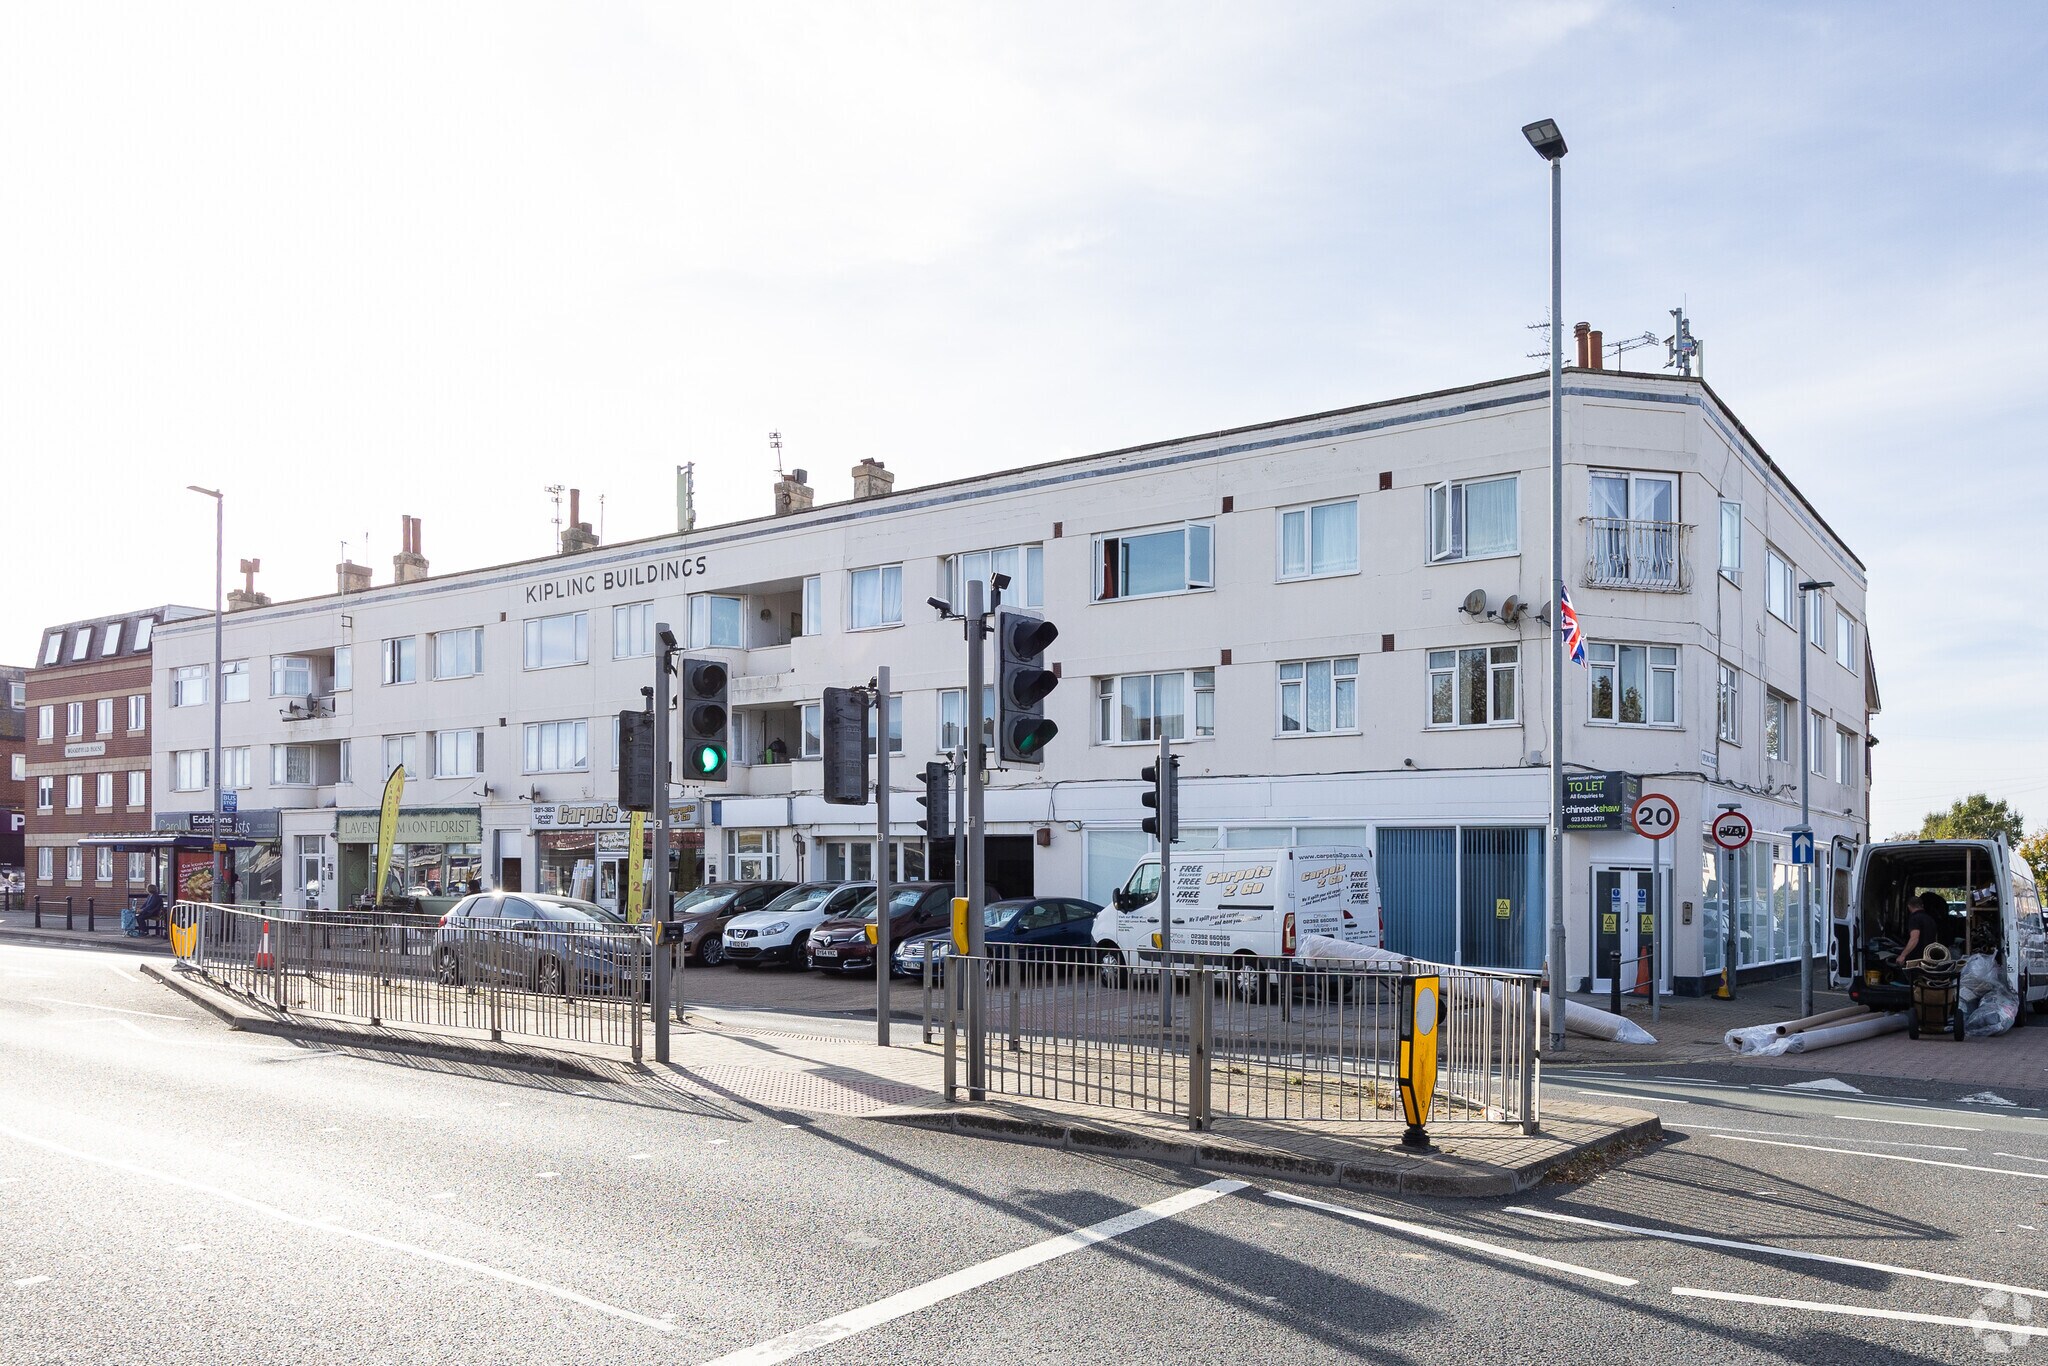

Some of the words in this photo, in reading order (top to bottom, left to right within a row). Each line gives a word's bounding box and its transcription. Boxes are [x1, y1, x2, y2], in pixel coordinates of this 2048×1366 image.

[526, 575, 595, 604] KIPLING
[603, 555, 707, 590] BUILDINGS
[1568, 782, 1583, 792] TO
[1585, 781, 1604, 791] LET
[557, 803, 618, 827] Carpets
[1565, 804, 1620, 814] chinneckshaw
[192, 815, 233, 824] Eddions
[1638, 807, 1672, 826] 20
[430, 819, 472, 833] FLORIST
[1298, 852, 1364, 860] www.carpets2go.co.uk
[1179, 865, 1203, 873] FREE
[1205, 865, 1273, 885] Carpets
[1301, 864, 1346, 882] Carpets
[1350, 870, 1368, 878] FREE
[1317, 878, 1326, 888] 2
[1328, 875, 1343, 885] Go
[1350, 881, 1369, 889] FREE
[1176, 890, 1201, 898] FREE
[1223, 883, 1238, 897] 2
[1240, 882, 1264, 895] Go
